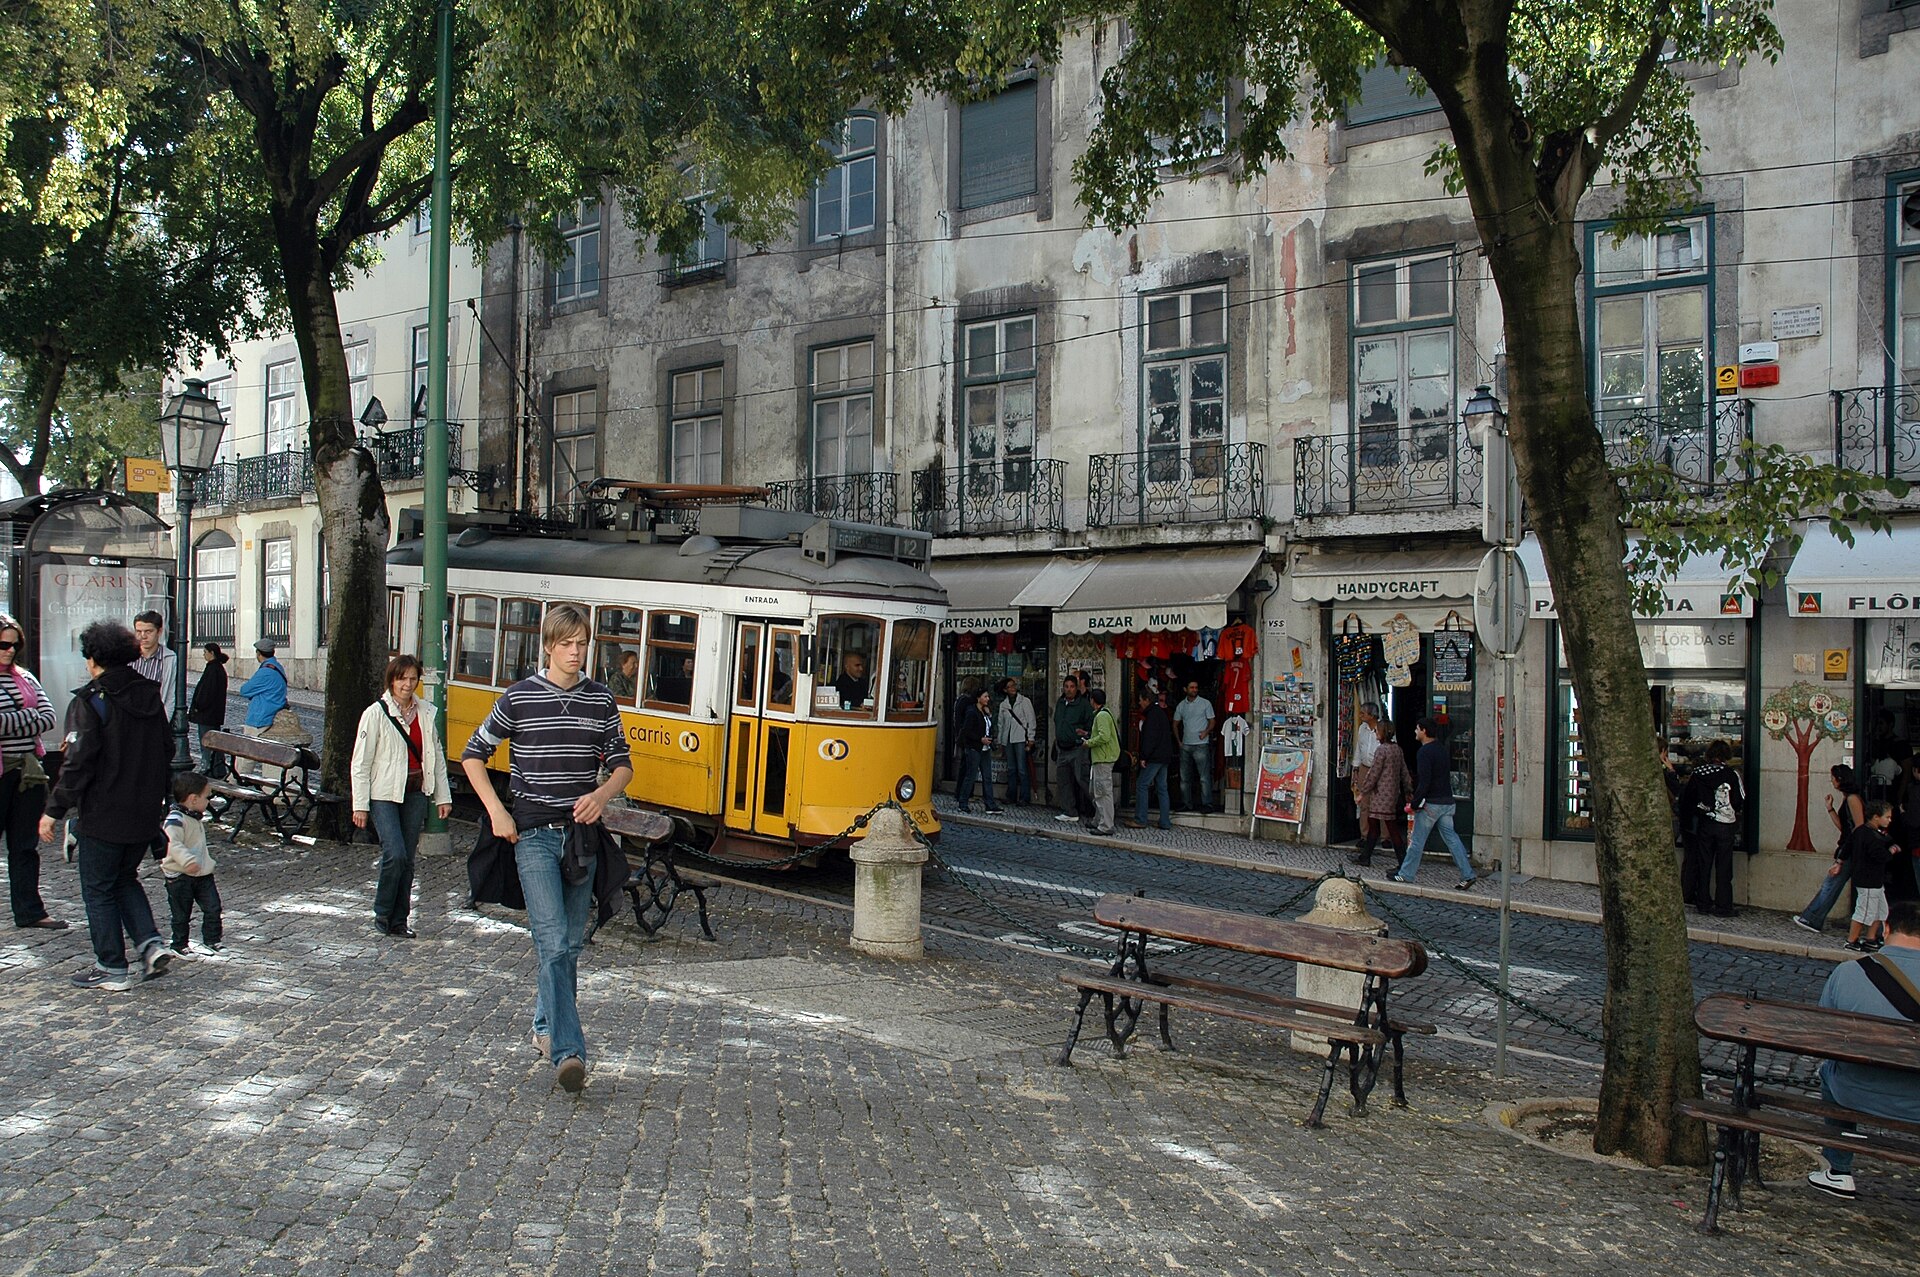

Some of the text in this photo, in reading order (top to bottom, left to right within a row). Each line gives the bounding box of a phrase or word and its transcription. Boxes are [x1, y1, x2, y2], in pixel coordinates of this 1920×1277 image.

[904, 540, 918, 556] 12
[55, 574, 154, 588] CLARINS
[540, 580, 550, 589] 582
[1337, 581, 1439, 595] HANDYCRAFT
[745, 596, 779, 605] ENTRADA
[915, 605, 927, 615] 582
[1089, 614, 1186, 628] BAZAR MUMI
[1640, 635, 1650, 646] A
[1694, 635, 1713, 646] DA
[1718, 632, 1735, 646] SÉ
[1233, 668, 1239, 689] 7
[1436, 683, 1467, 691] MUMI
[629, 725, 671, 746] carris
